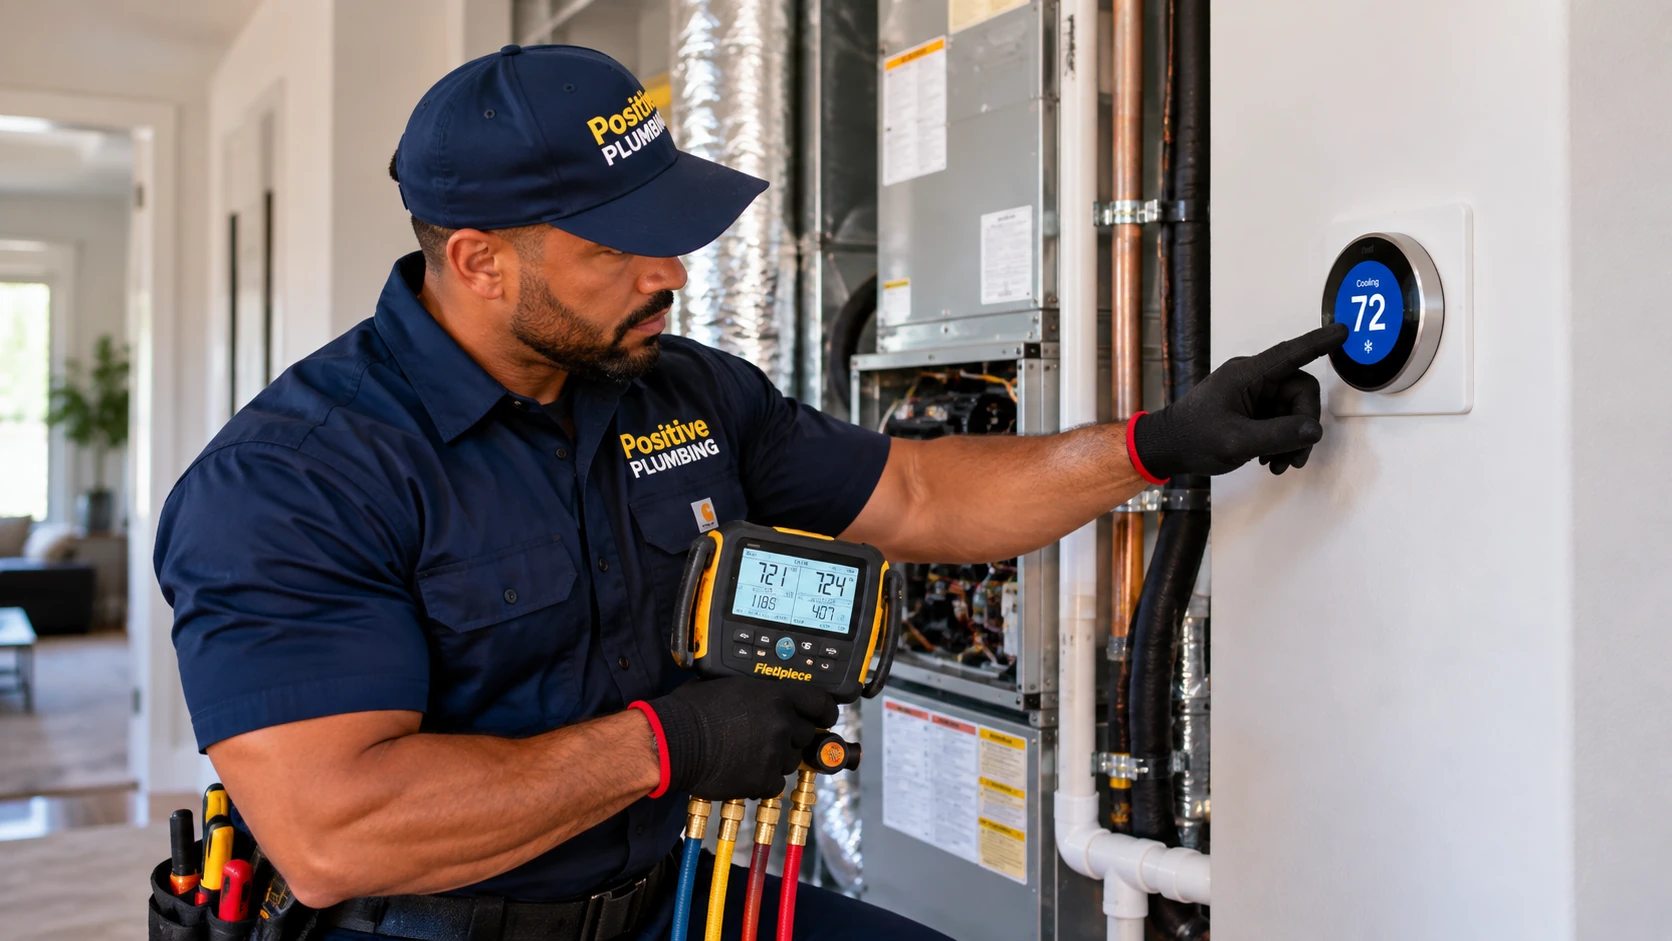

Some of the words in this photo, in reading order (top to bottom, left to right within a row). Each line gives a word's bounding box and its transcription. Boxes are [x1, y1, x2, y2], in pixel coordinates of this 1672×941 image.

[1356, 278, 1379, 288] Cooling
[1351, 293, 1386, 332] 72
[619, 419, 710, 460] Positive
[629, 438, 720, 479] PLUMBING
[816, 571, 847, 597] 724
[812, 604, 835, 621] 407
